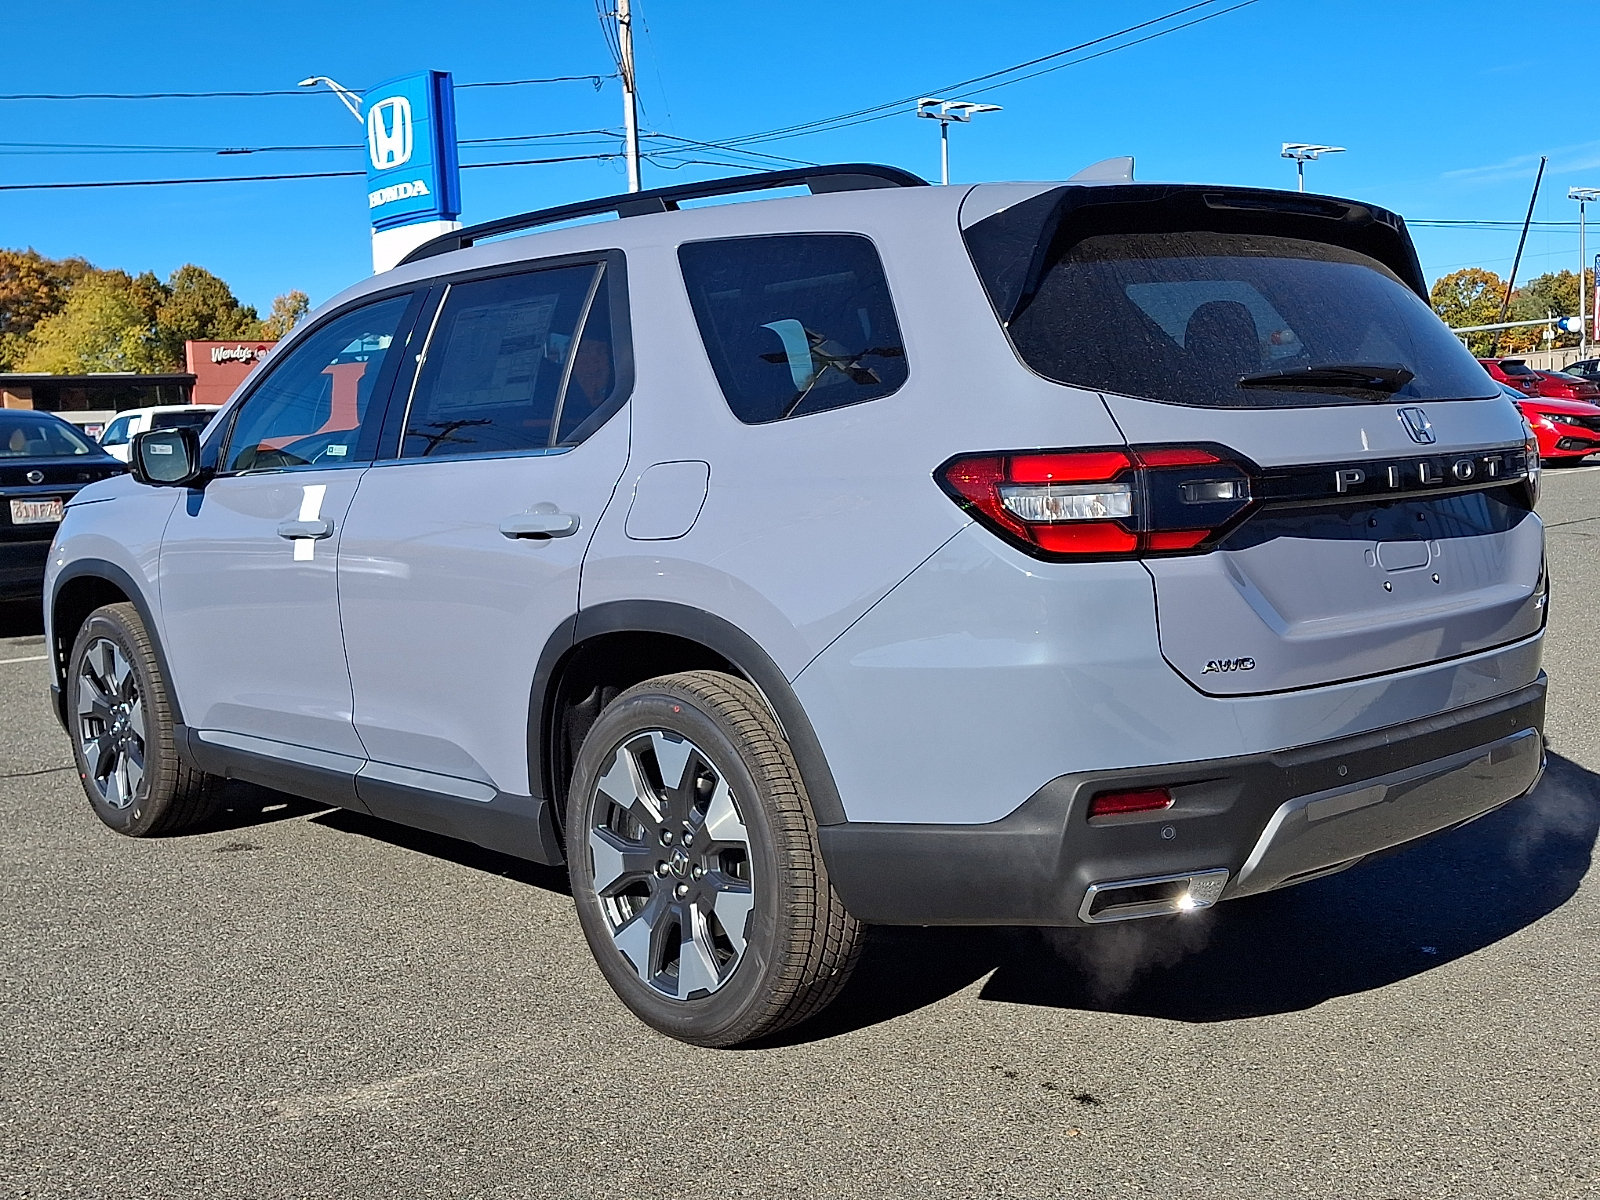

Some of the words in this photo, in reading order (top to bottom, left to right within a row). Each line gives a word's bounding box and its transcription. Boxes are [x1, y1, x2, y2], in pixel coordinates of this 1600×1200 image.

[368, 179, 430, 209] HONDA
[211, 345, 251, 362] Wendy's
[1335, 455, 1502, 493] PILOT
[1200, 657, 1256, 674] AWD
